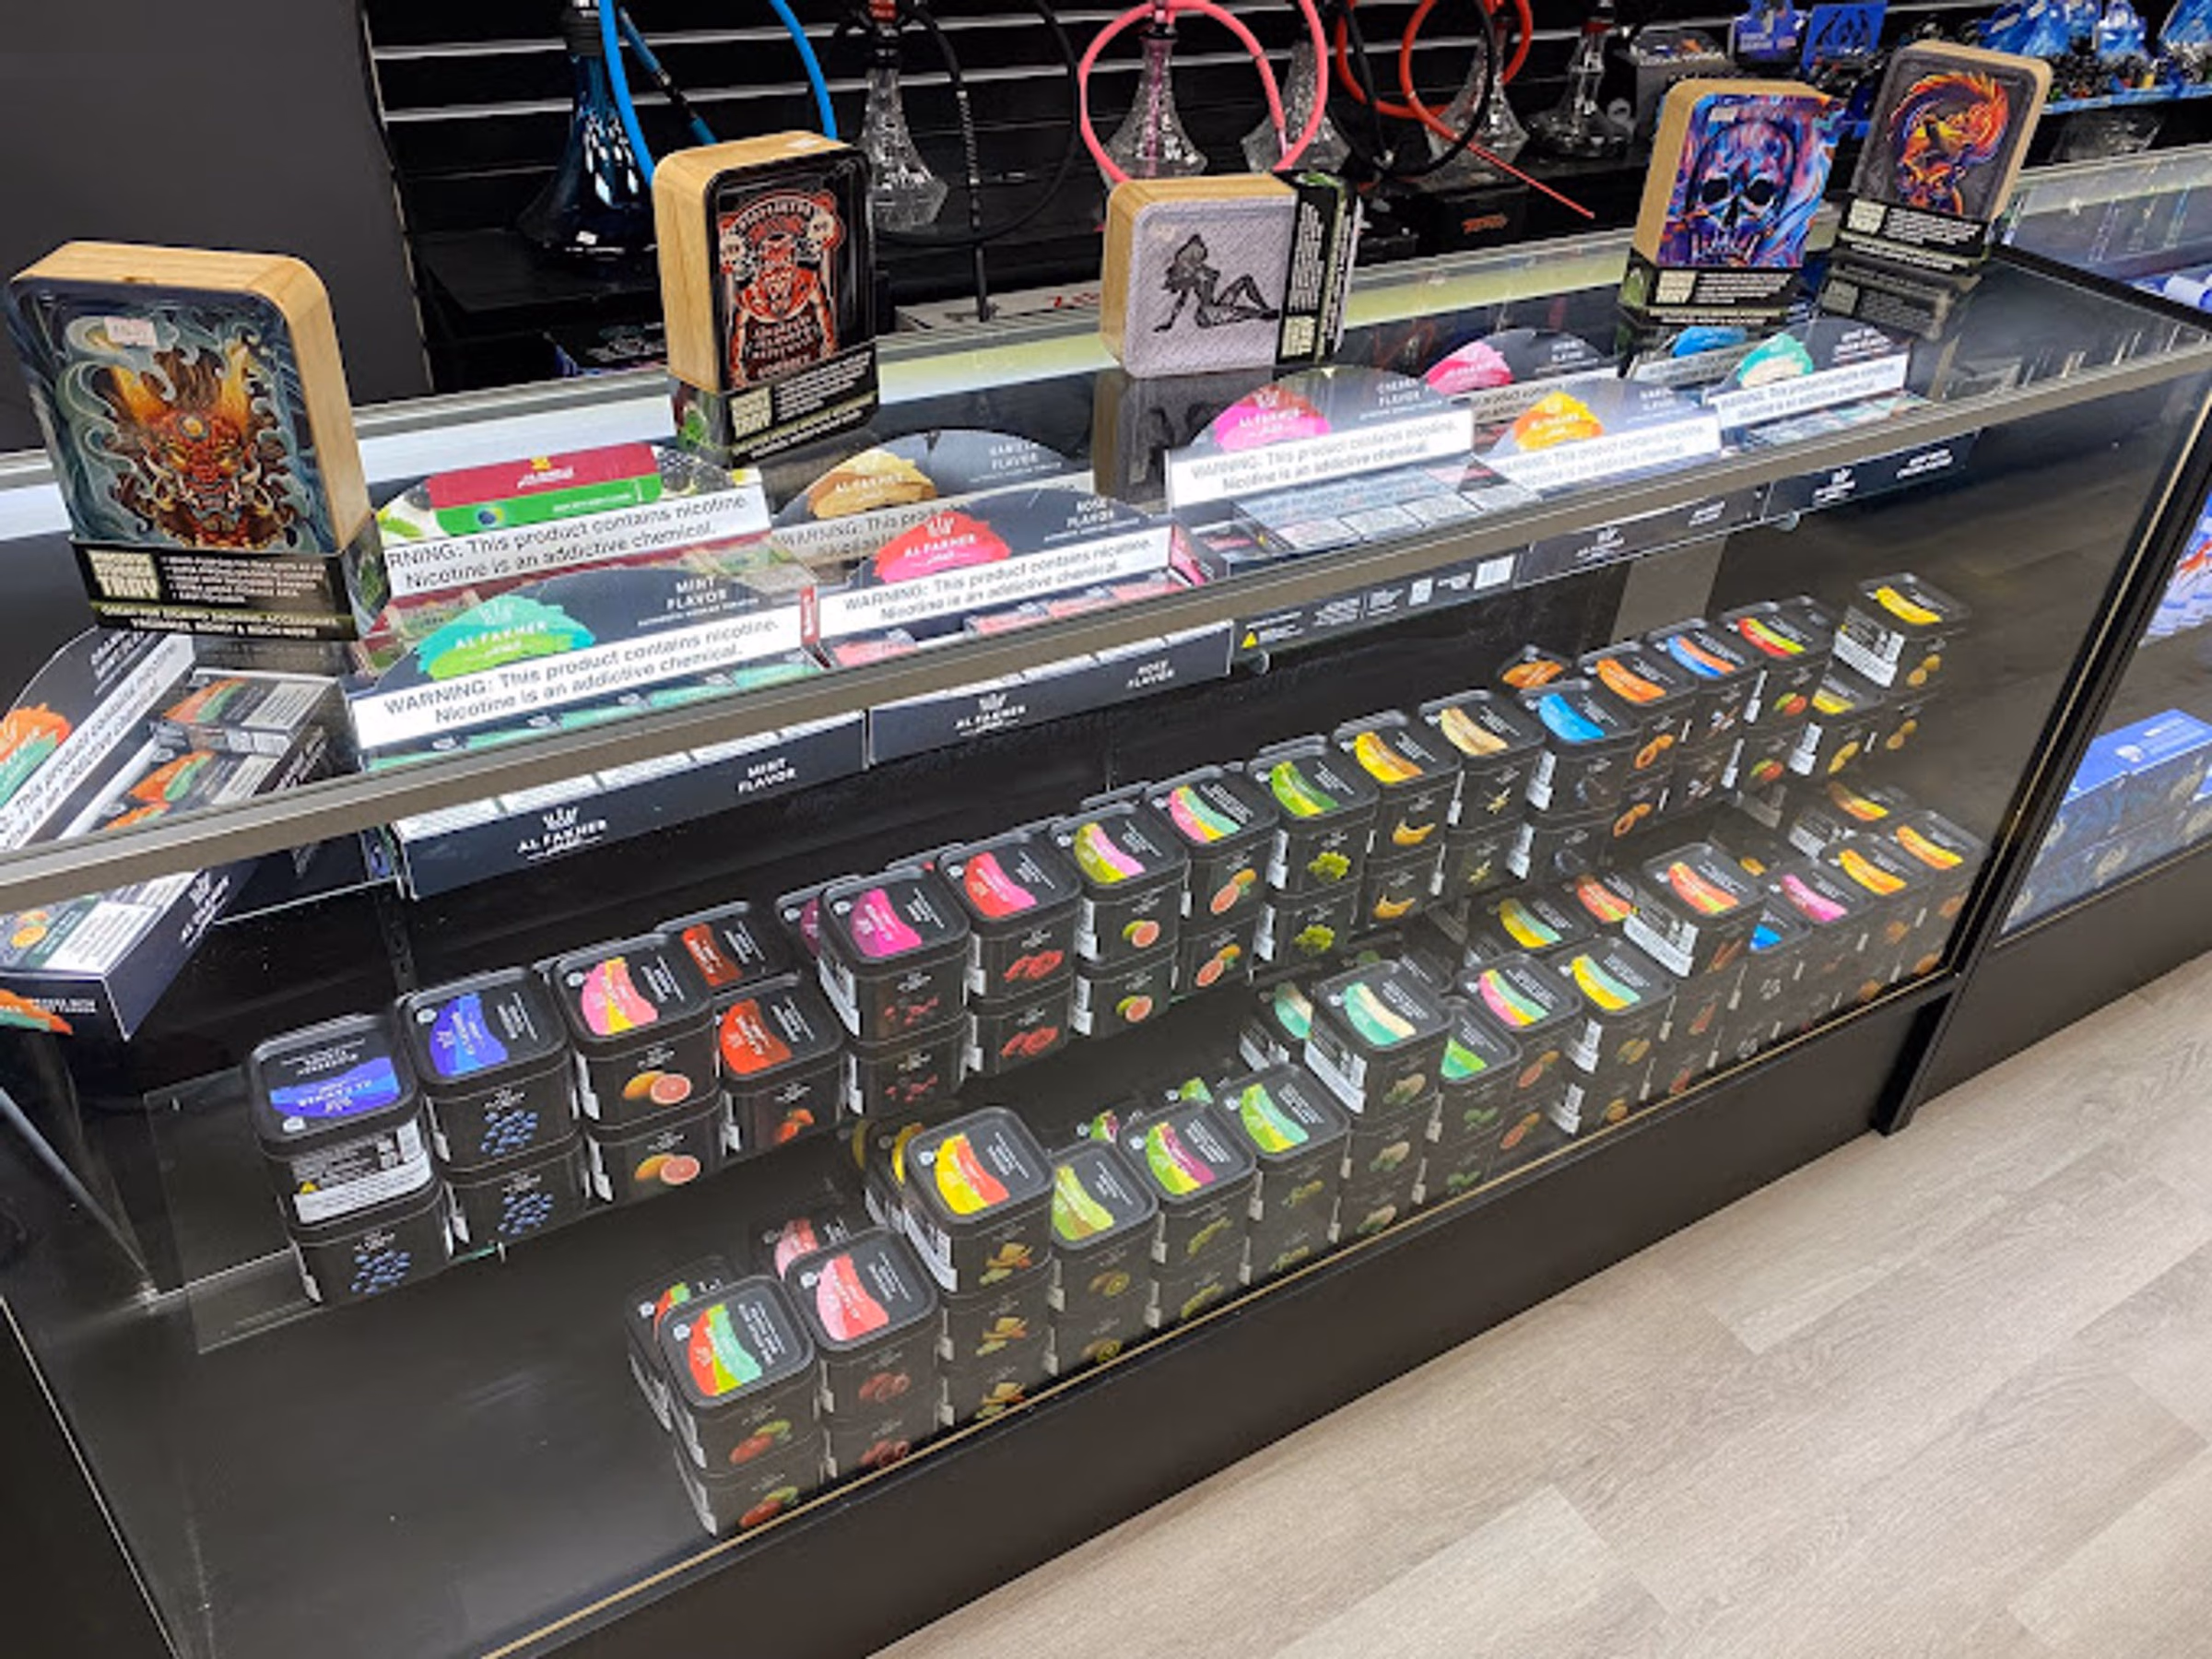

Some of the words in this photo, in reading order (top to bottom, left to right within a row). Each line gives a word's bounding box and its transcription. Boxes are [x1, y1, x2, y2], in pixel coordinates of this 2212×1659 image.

[465, 536, 509, 553] This
[514, 523, 587, 550] product
[592, 511, 671, 535] contains
[406, 563, 489, 589] Nicotine
[493, 559, 509, 574] is
[516, 557, 538, 571] an
[543, 539, 629, 564] addictive
[631, 521, 717, 548] chemical.
[676, 576, 715, 594] MINT
[935, 579, 964, 592] This
[666, 589, 727, 610] FLAVOR
[947, 594, 960, 606] is
[384, 679, 493, 715] WARNING:
[499, 670, 541, 688] This
[547, 651, 618, 681] product
[625, 635, 701, 662] contains
[705, 618, 779, 644] nicotine.
[435, 698, 516, 724] Nicotine
[521, 689, 538, 704] is
[544, 684, 568, 699] an
[571, 664, 655, 692] addictive
[660, 644, 743, 670] chemical.
[738, 768, 798, 794] FLAVOR
[747, 758, 786, 778] MINT
[517, 839, 541, 854] AL
[542, 819, 607, 847] FAKHER
